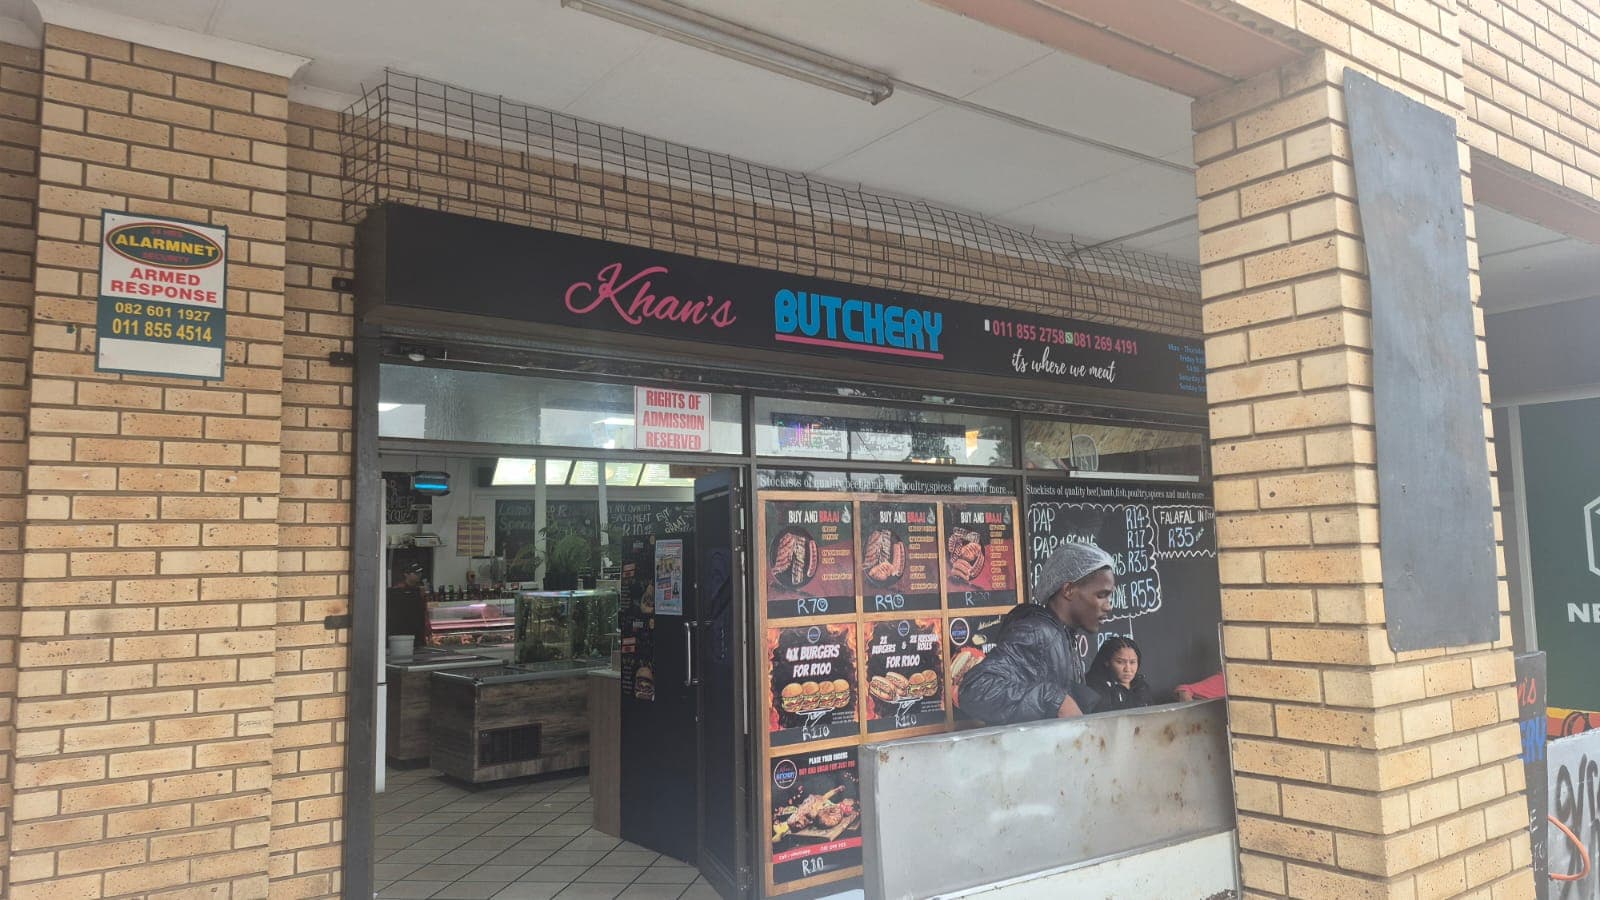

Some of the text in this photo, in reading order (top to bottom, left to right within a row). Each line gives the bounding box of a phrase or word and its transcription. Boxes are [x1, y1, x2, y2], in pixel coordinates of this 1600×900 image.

[115, 234, 216, 257] ALARMNET
[130, 267, 200, 286] ARMED
[111, 279, 217, 303] RESPONSE
[564, 262, 737, 327] Khan's
[115, 302, 211, 322] 082 601 1927
[774, 288, 943, 352] BUTCHERY
[112, 318, 212, 342] 011 855 4514
[992, 320, 1065, 345] 011 855 2758
[1074, 332, 1138, 356] 081 269 4191
[1011, 346, 1116, 383] its where we meat
[646, 390, 701, 410] RIGHTS OF
[643, 410, 704, 430] ADMISSION
[646, 431, 701, 450] RESERVED
[1026, 484, 1056, 495] Stockists
[1057, 485, 1063, 495] of
[1065, 486, 1085, 498] quality
[788, 510, 803, 523] BUY
[804, 510, 818, 523] AND
[880, 511, 893, 523] BUY
[893, 511, 906, 523] AND
[960, 511, 972, 524] BUY
[1033, 507, 1055, 534] PAP
[1126, 508, 1145, 530] R14
[1160, 509, 1195, 525] FALAFAL
[1034, 535, 1057, 559] PAP
[1168, 526, 1194, 548] R35
[1128, 550, 1149, 573] R35
[1130, 578, 1156, 608] R55
[785, 644, 840, 662] 4X BURGERS
[886, 654, 920, 669] FOR R100
[792, 662, 831, 678] FOR R100
